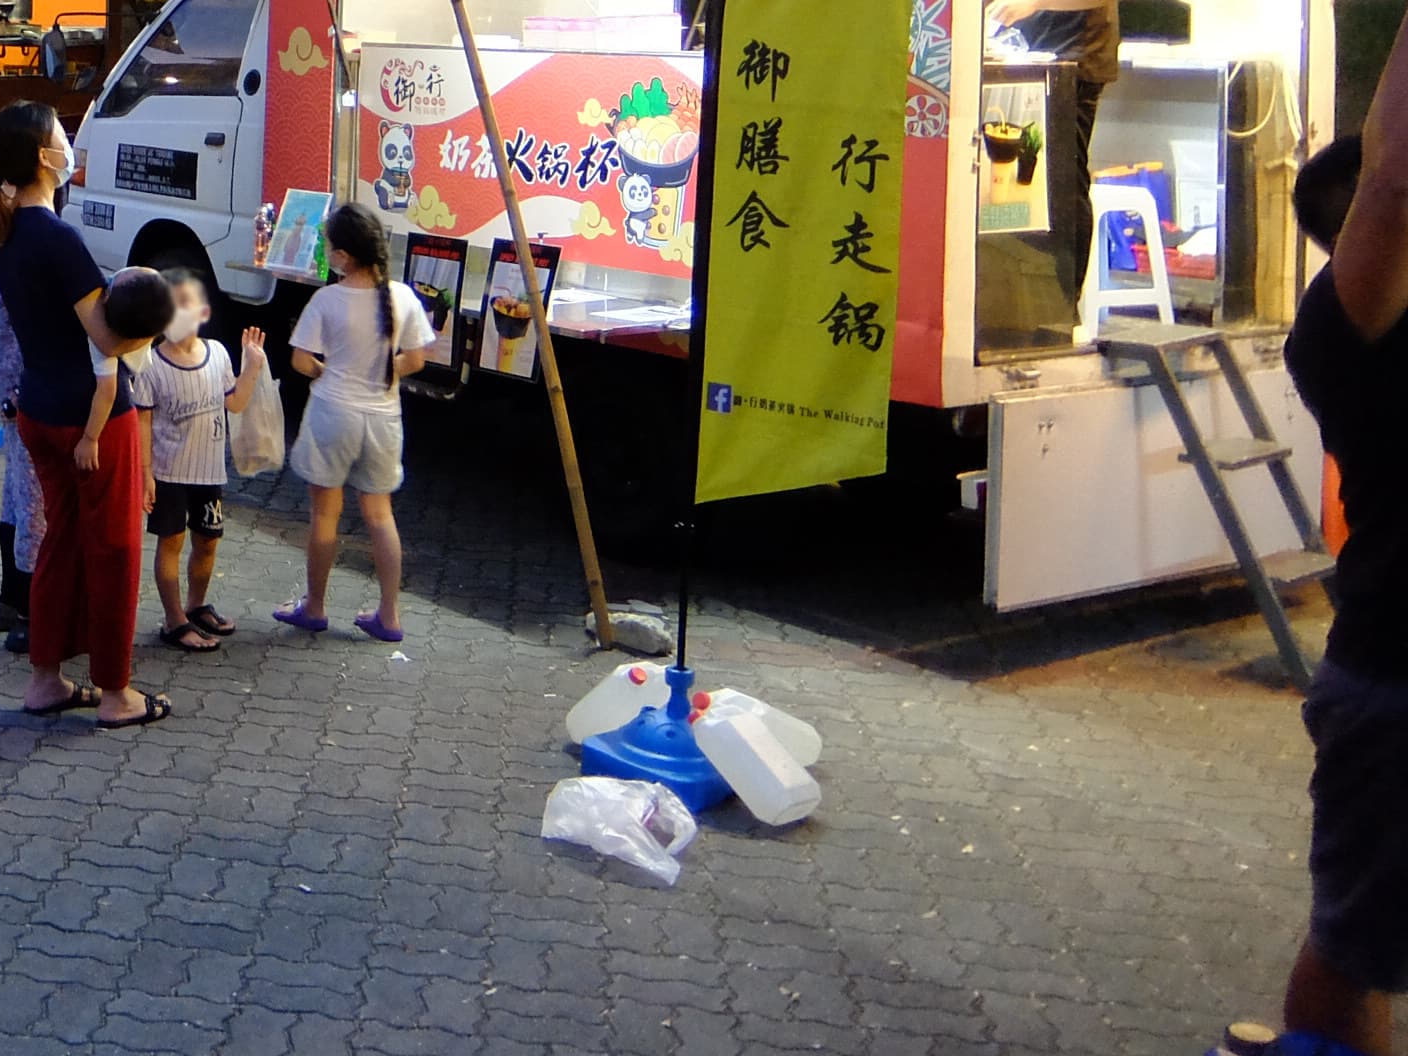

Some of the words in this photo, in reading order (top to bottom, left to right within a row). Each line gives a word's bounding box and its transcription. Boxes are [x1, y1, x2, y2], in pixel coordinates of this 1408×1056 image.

[799, 406, 819, 419] The
[824, 408, 864, 427] Walking
[866, 416, 885, 430] Pot
